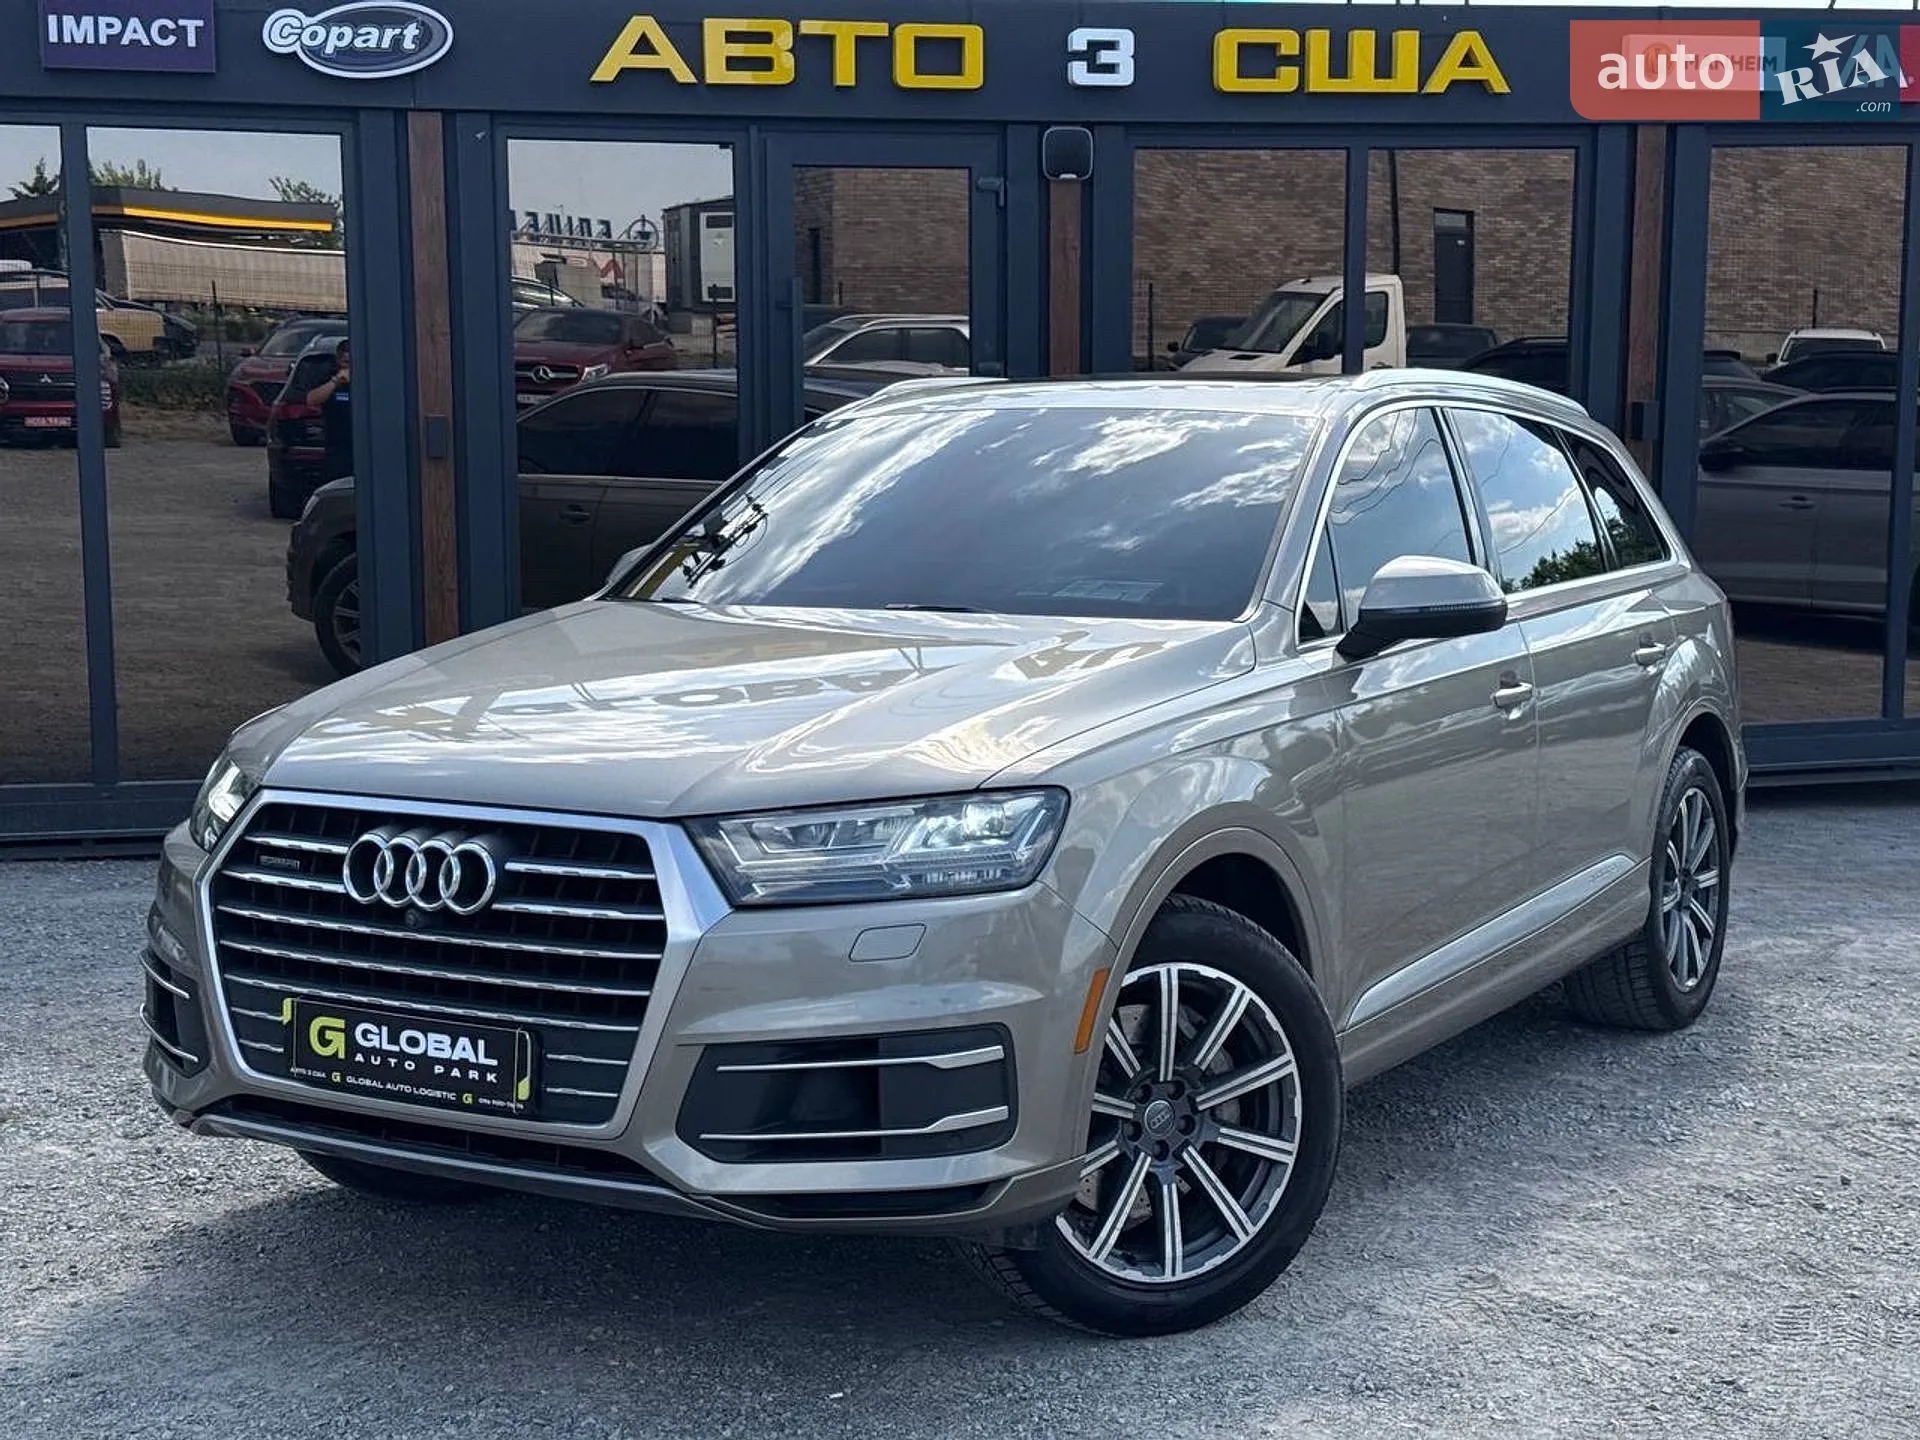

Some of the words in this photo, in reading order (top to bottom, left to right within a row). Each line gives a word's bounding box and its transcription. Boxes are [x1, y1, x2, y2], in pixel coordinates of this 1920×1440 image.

[47, 14, 204, 49] IMPACT
[266, 11, 422, 55] Copart
[590, 14, 984, 89] АВТО
[1213, 28, 1512, 94] США
[354, 1022, 498, 1066] GLOBAL
[354, 1052, 416, 1071] AUTO
[434, 1065, 498, 1084] PARK
[346, 1075, 384, 1089] GLOBAL
[386, 1082, 412, 1094] AUTO
[413, 1087, 457, 1101] LOGISTIC
